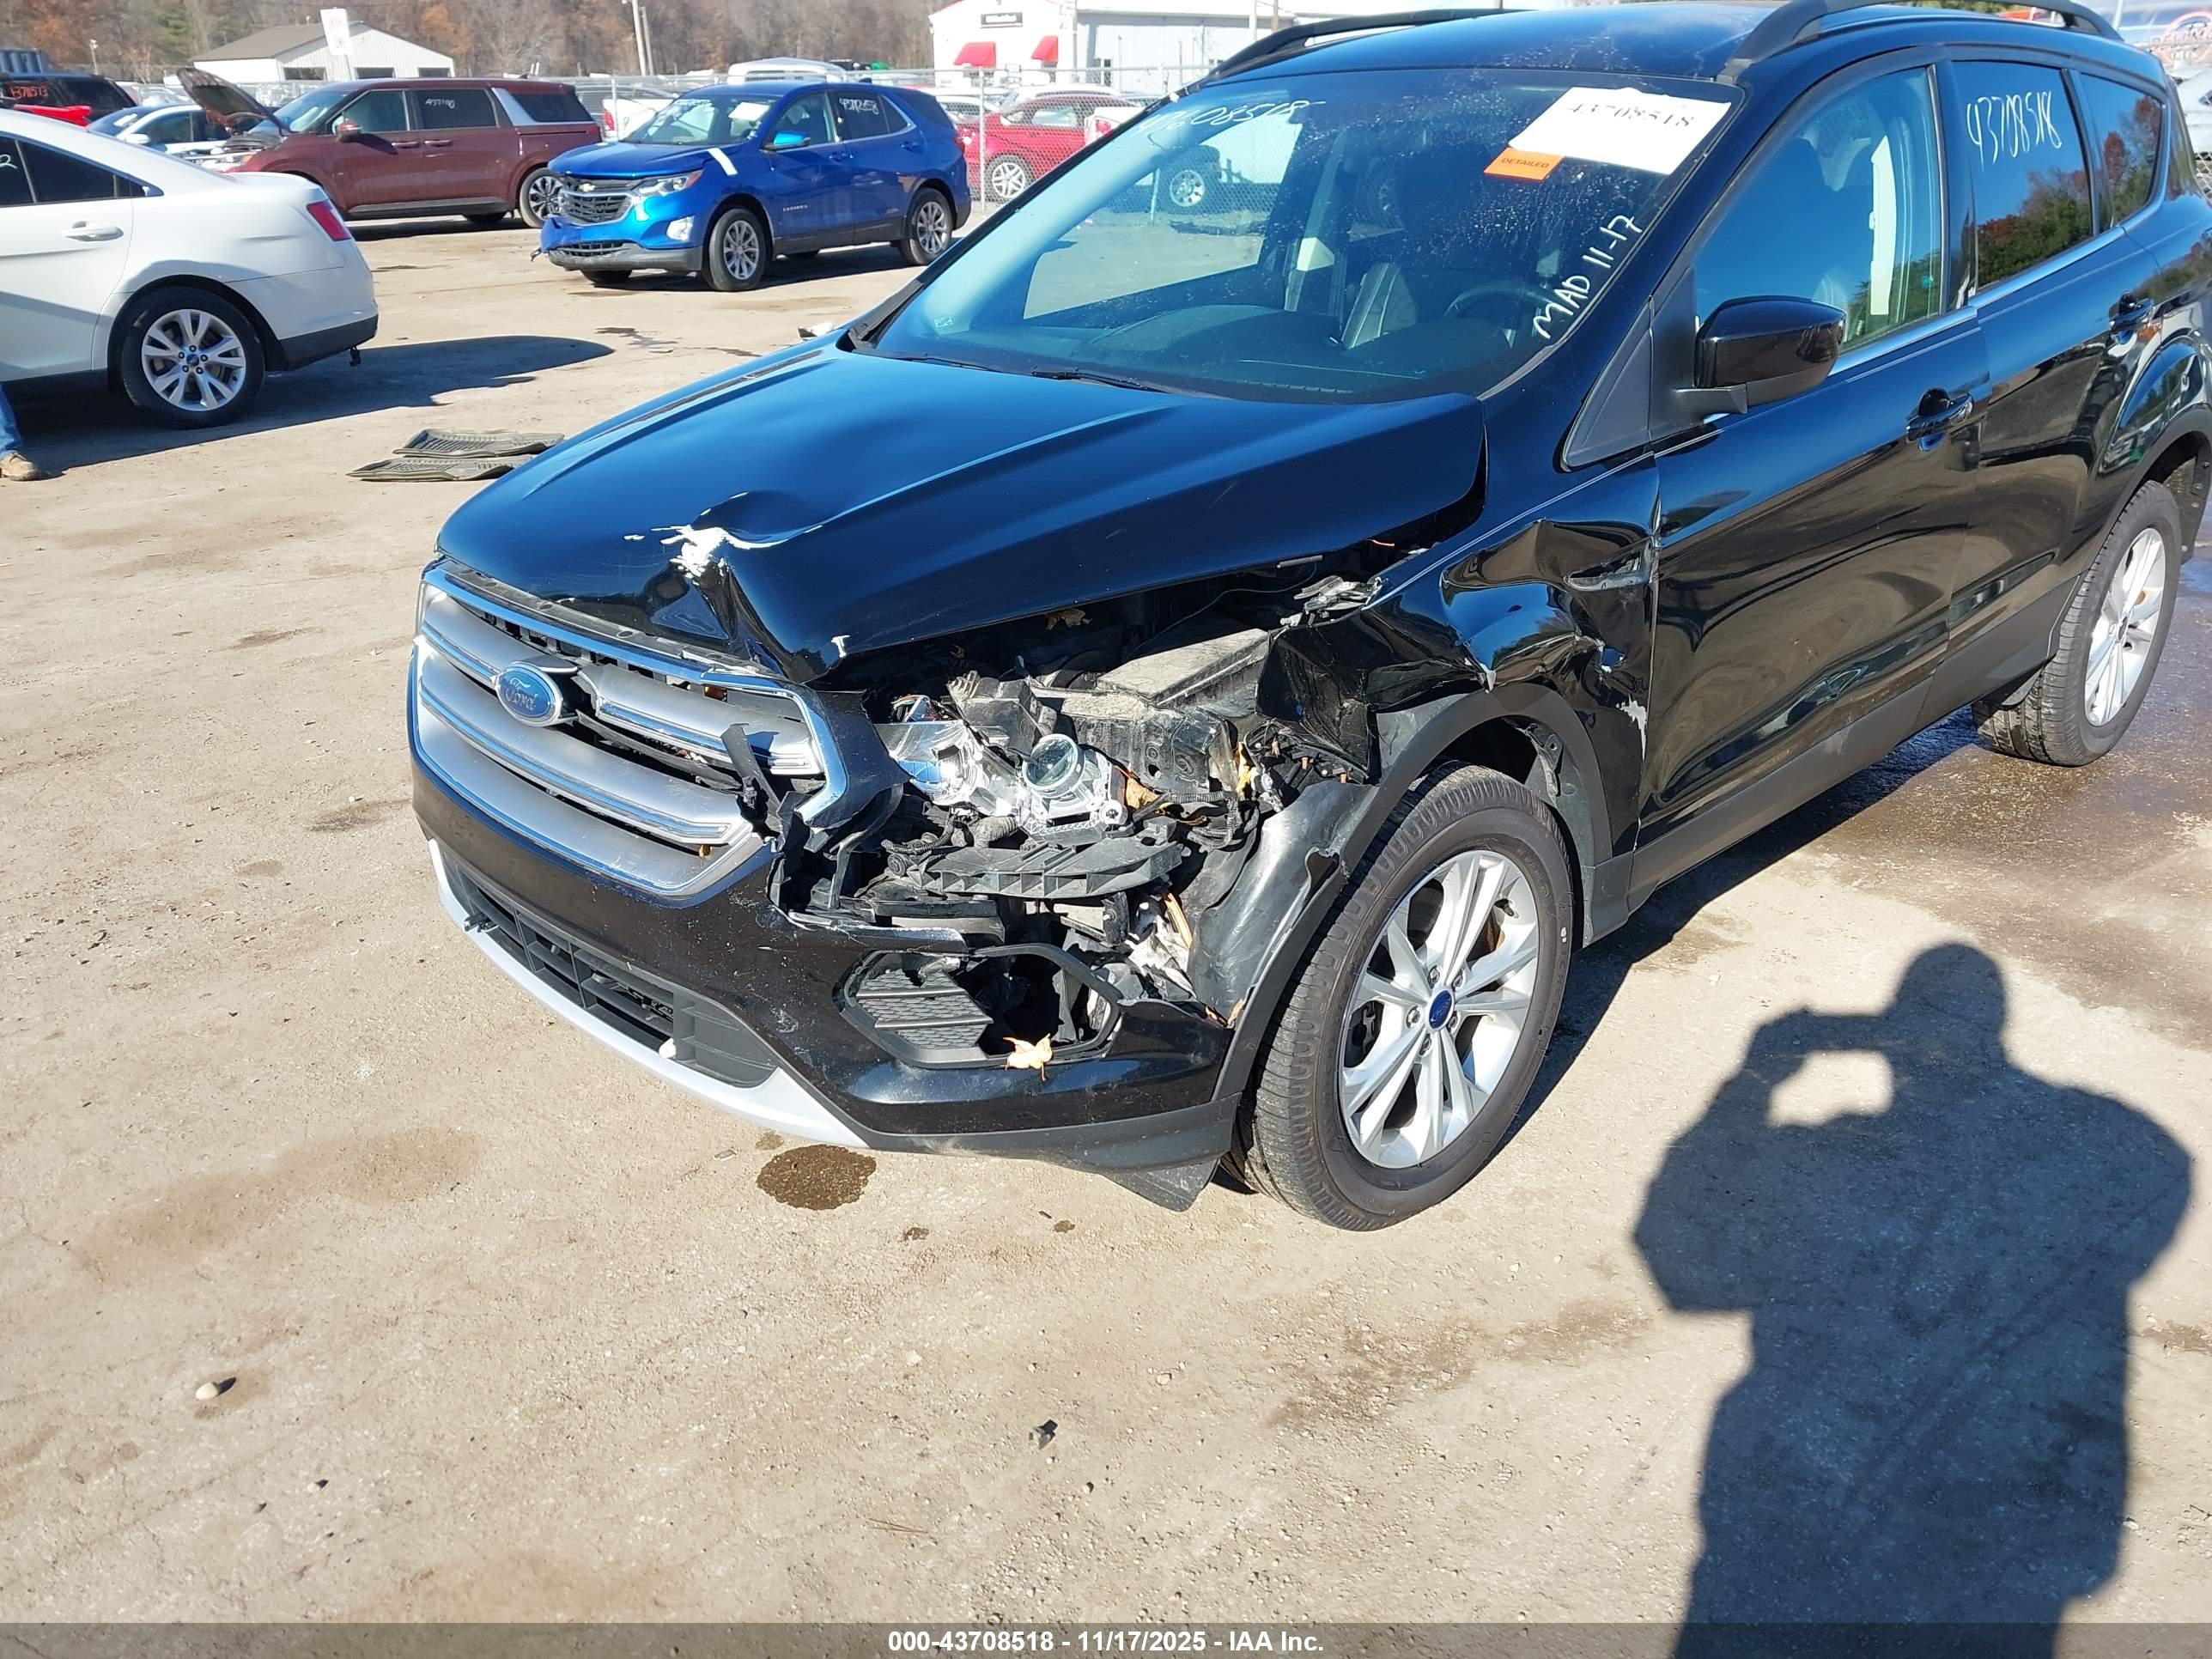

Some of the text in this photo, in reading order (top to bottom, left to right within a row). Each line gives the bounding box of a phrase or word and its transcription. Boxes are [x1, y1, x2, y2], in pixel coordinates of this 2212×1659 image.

[1500, 157, 1550, 169] DETAILED
[1966, 90, 2063, 174] 43708518
[1533, 215, 1643, 339] MAD 11-17
